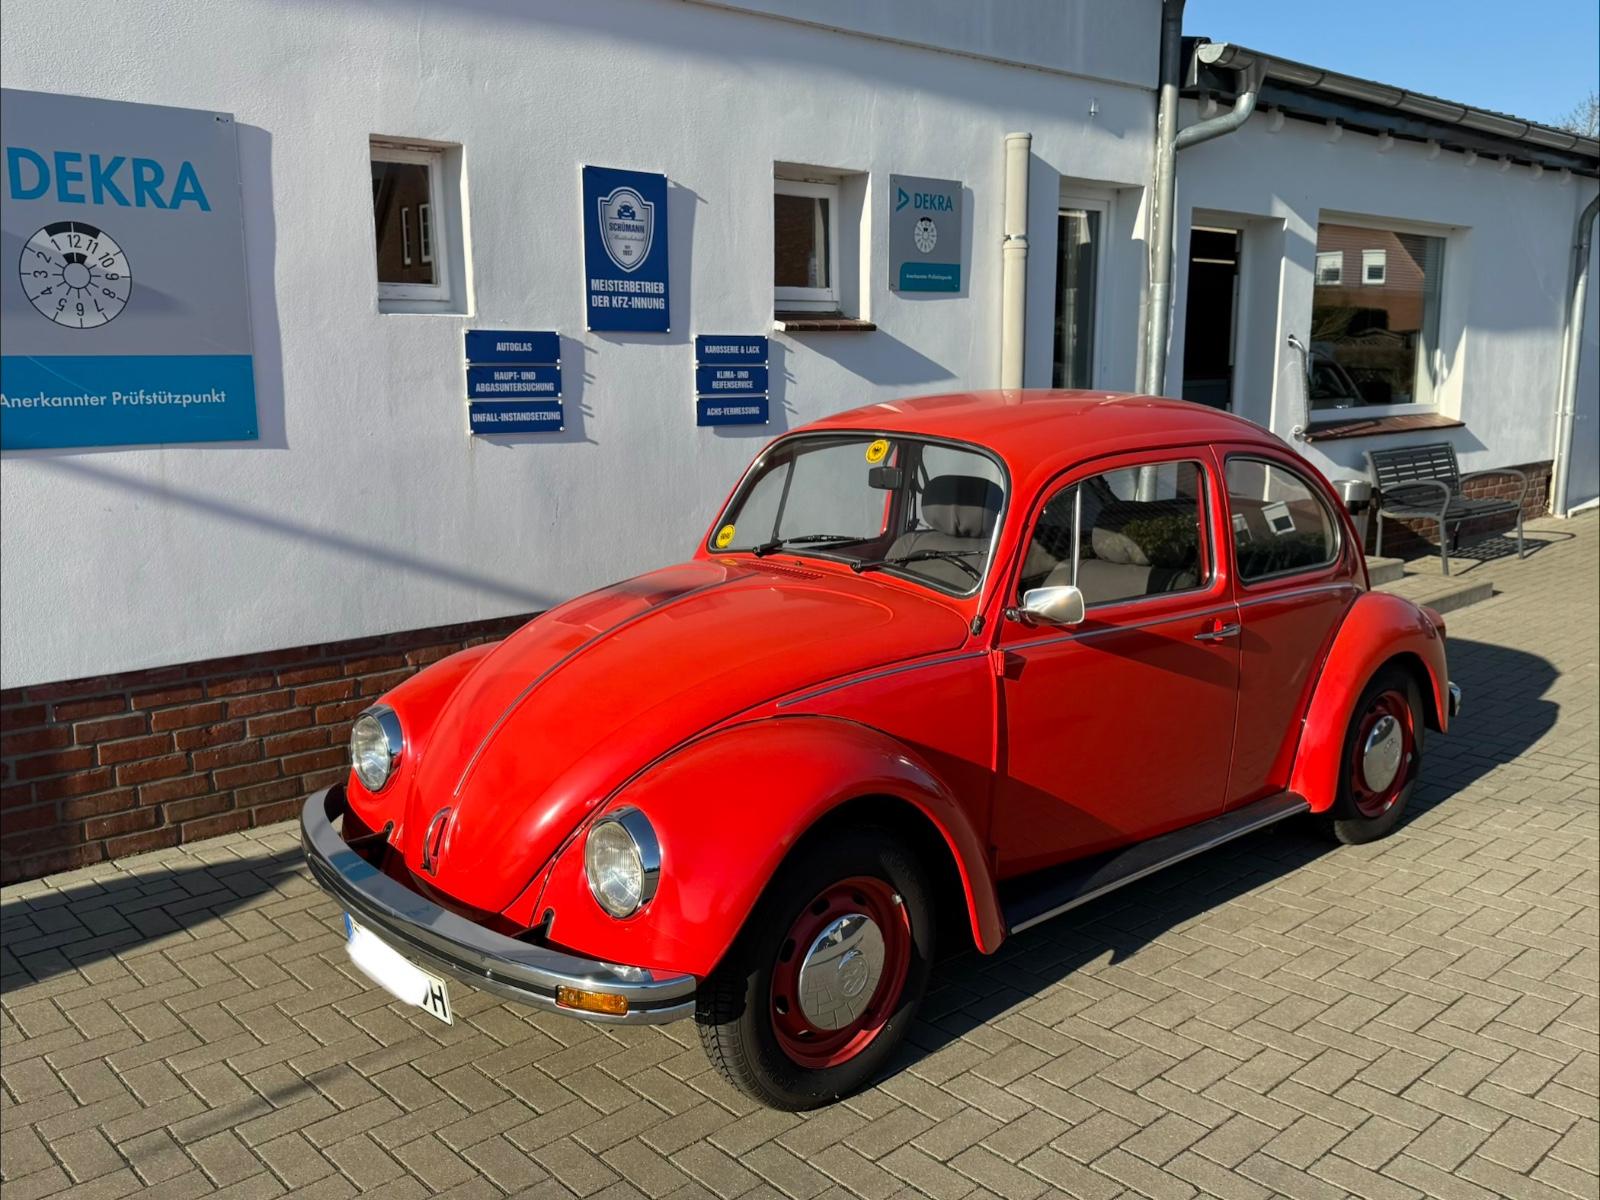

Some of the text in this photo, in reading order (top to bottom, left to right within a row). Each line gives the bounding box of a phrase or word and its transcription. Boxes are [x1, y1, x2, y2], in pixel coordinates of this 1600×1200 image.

[6, 147, 212, 212] DEKRA
[914, 192, 954, 212] DEKRA
[50, 238, 61, 251] 1
[67, 234, 82, 248] 12
[86, 239, 99, 254] 11
[36, 251, 52, 263] 2
[98, 252, 115, 268] 10
[33, 270, 48, 278] 3
[40, 286, 53, 295] 4
[591, 278, 665, 294] MEISTERBETRIEB
[102, 288, 116, 299] 8
[56, 298, 67, 312] 5
[591, 295, 665, 310] DER KFZ-INNUNG
[496, 342, 532, 352] AUTOGLAS
[704, 345, 740, 354] KAROSSERIE
[746, 345, 760, 354] LACK
[494, 371, 536, 380] HAUPT- UND
[716, 371, 749, 379] KLIMA- UND
[475, 382, 555, 392] ABGASUNTERSUCHUNG
[712, 380, 754, 389] REIFENSERVICE
[0, 388, 226, 408] Anerkannter Prüfstützpunkt
[472, 411, 561, 423] UNFALL-INSTANDSETZUNG
[706, 406, 760, 416] ACHS-VERMESSUNG
